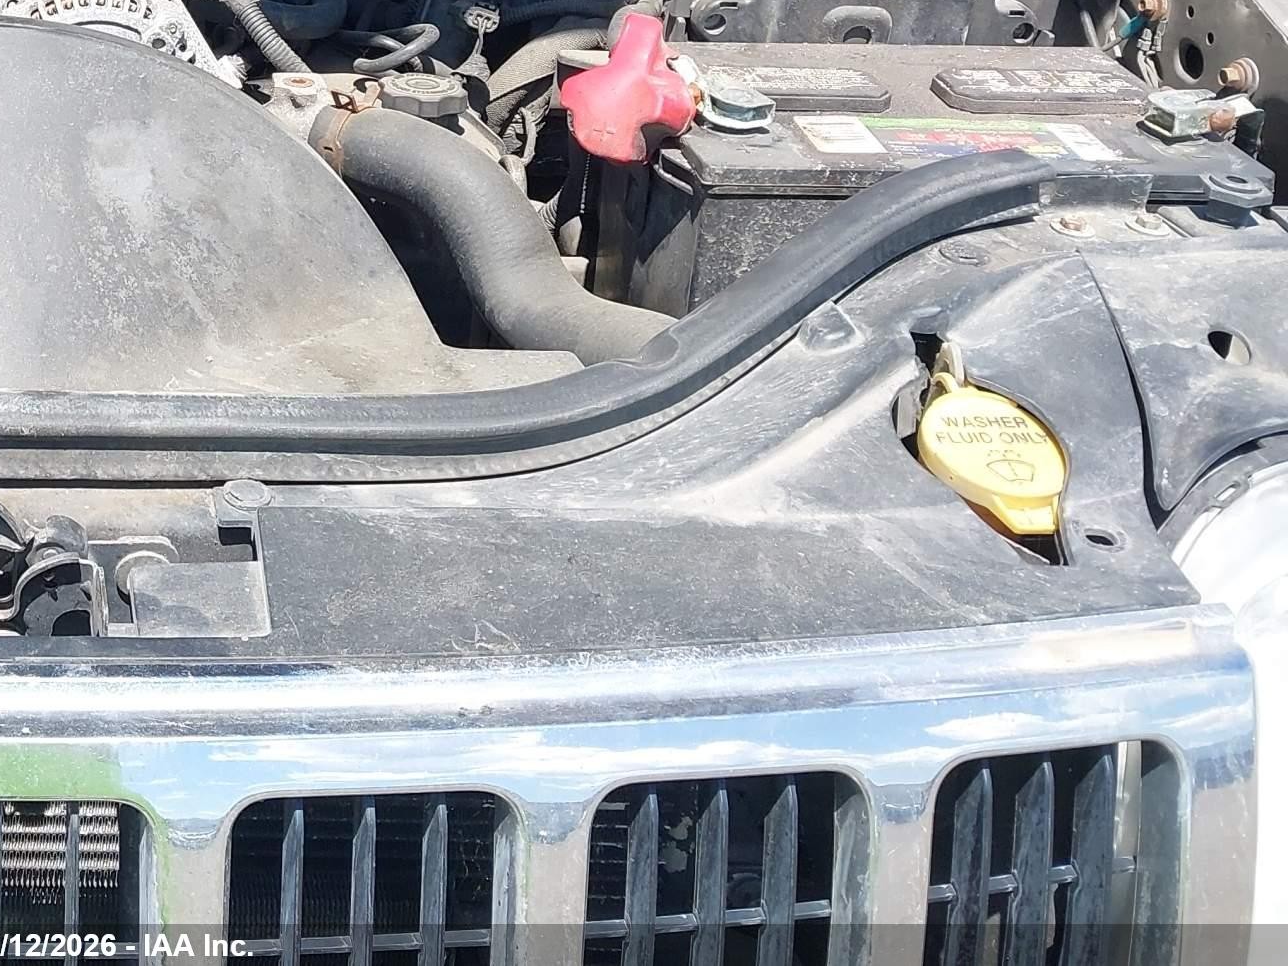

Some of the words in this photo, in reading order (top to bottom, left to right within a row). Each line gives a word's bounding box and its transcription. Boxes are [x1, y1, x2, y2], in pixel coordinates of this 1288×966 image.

[942, 416, 1029, 429] WASHER
[936, 431, 992, 444] FLUID
[1000, 431, 1049, 444] ONLY
